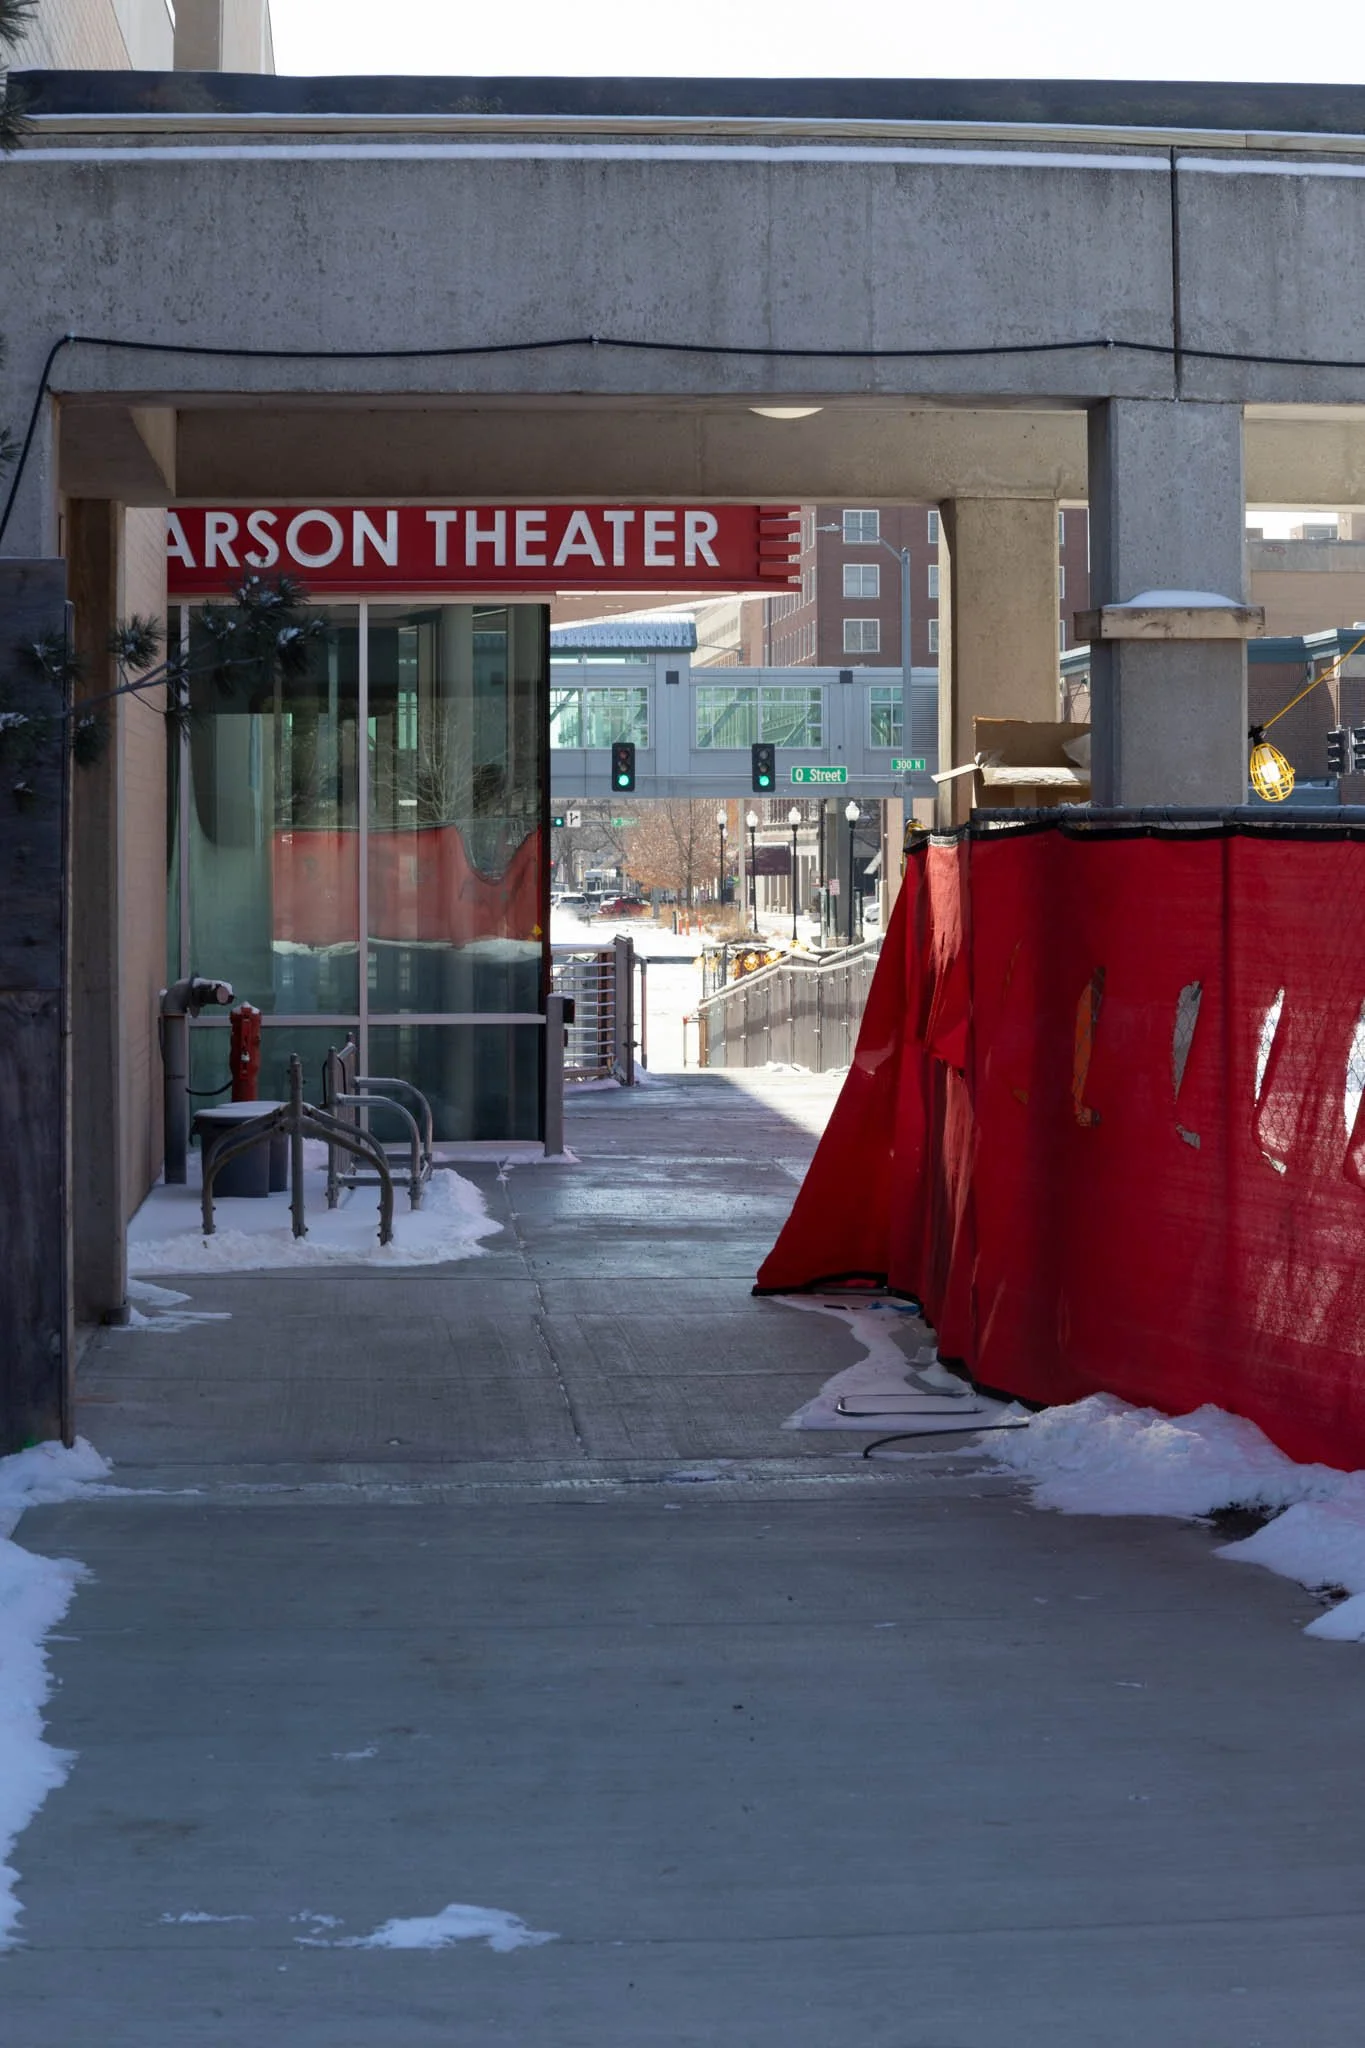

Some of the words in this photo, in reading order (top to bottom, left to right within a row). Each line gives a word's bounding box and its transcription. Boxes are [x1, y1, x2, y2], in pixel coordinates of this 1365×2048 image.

[427, 511, 720, 567] THEATER
[895, 760, 912, 769] 300
[914, 760, 921, 769] N
[809, 768, 841, 782] Street
